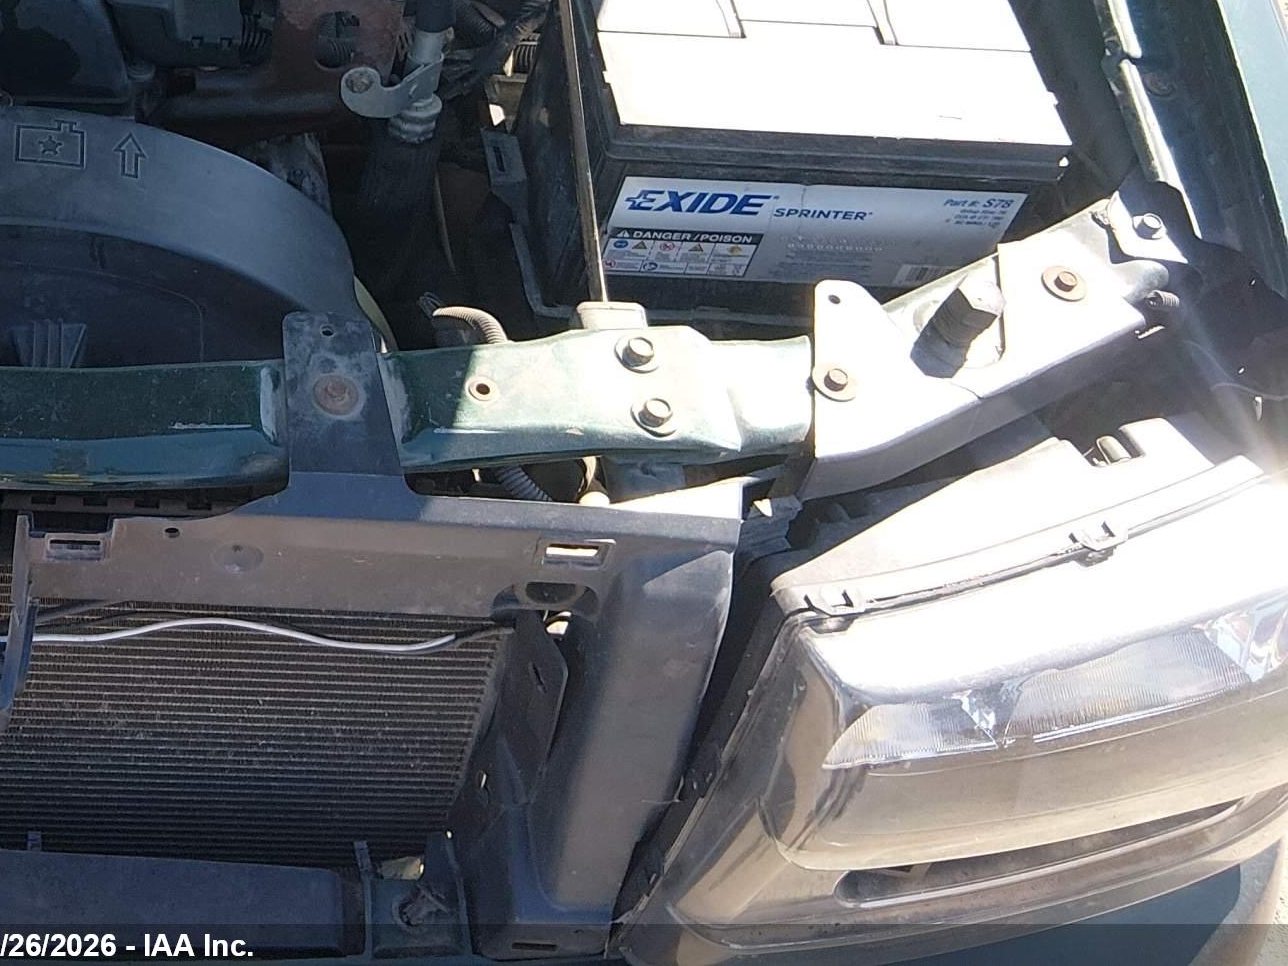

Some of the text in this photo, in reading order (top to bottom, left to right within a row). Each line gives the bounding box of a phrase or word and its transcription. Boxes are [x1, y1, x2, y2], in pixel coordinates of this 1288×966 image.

[625, 189, 772, 216] EXIDE
[943, 198, 968, 208] Part
[982, 198, 1015, 209] S78
[773, 207, 868, 221] SPRINTER
